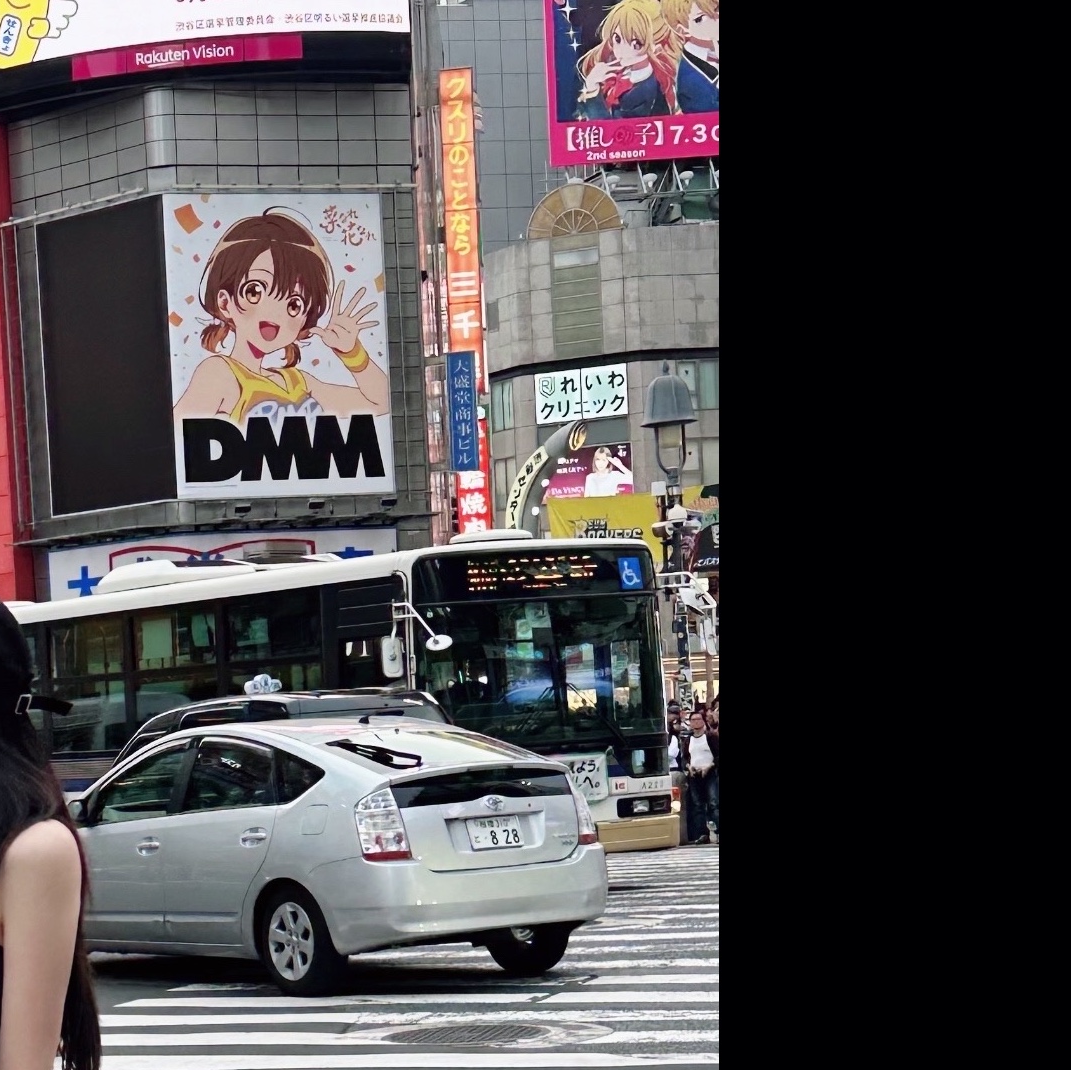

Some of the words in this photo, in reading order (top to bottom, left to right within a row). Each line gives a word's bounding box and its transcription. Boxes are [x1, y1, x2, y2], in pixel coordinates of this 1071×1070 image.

[135, 48, 190, 69] Rakuten
[192, 45, 234, 60] Vision
[447, 77, 471, 256] クスリのことなら
[586, 150, 607, 161] 2nd
[608, 149, 646, 160] season
[560, 371, 624, 395] れいわ
[453, 358, 473, 464] 大盛堂商事ビル
[540, 394, 625, 420] クリニック
[182, 414, 386, 483] DMM
